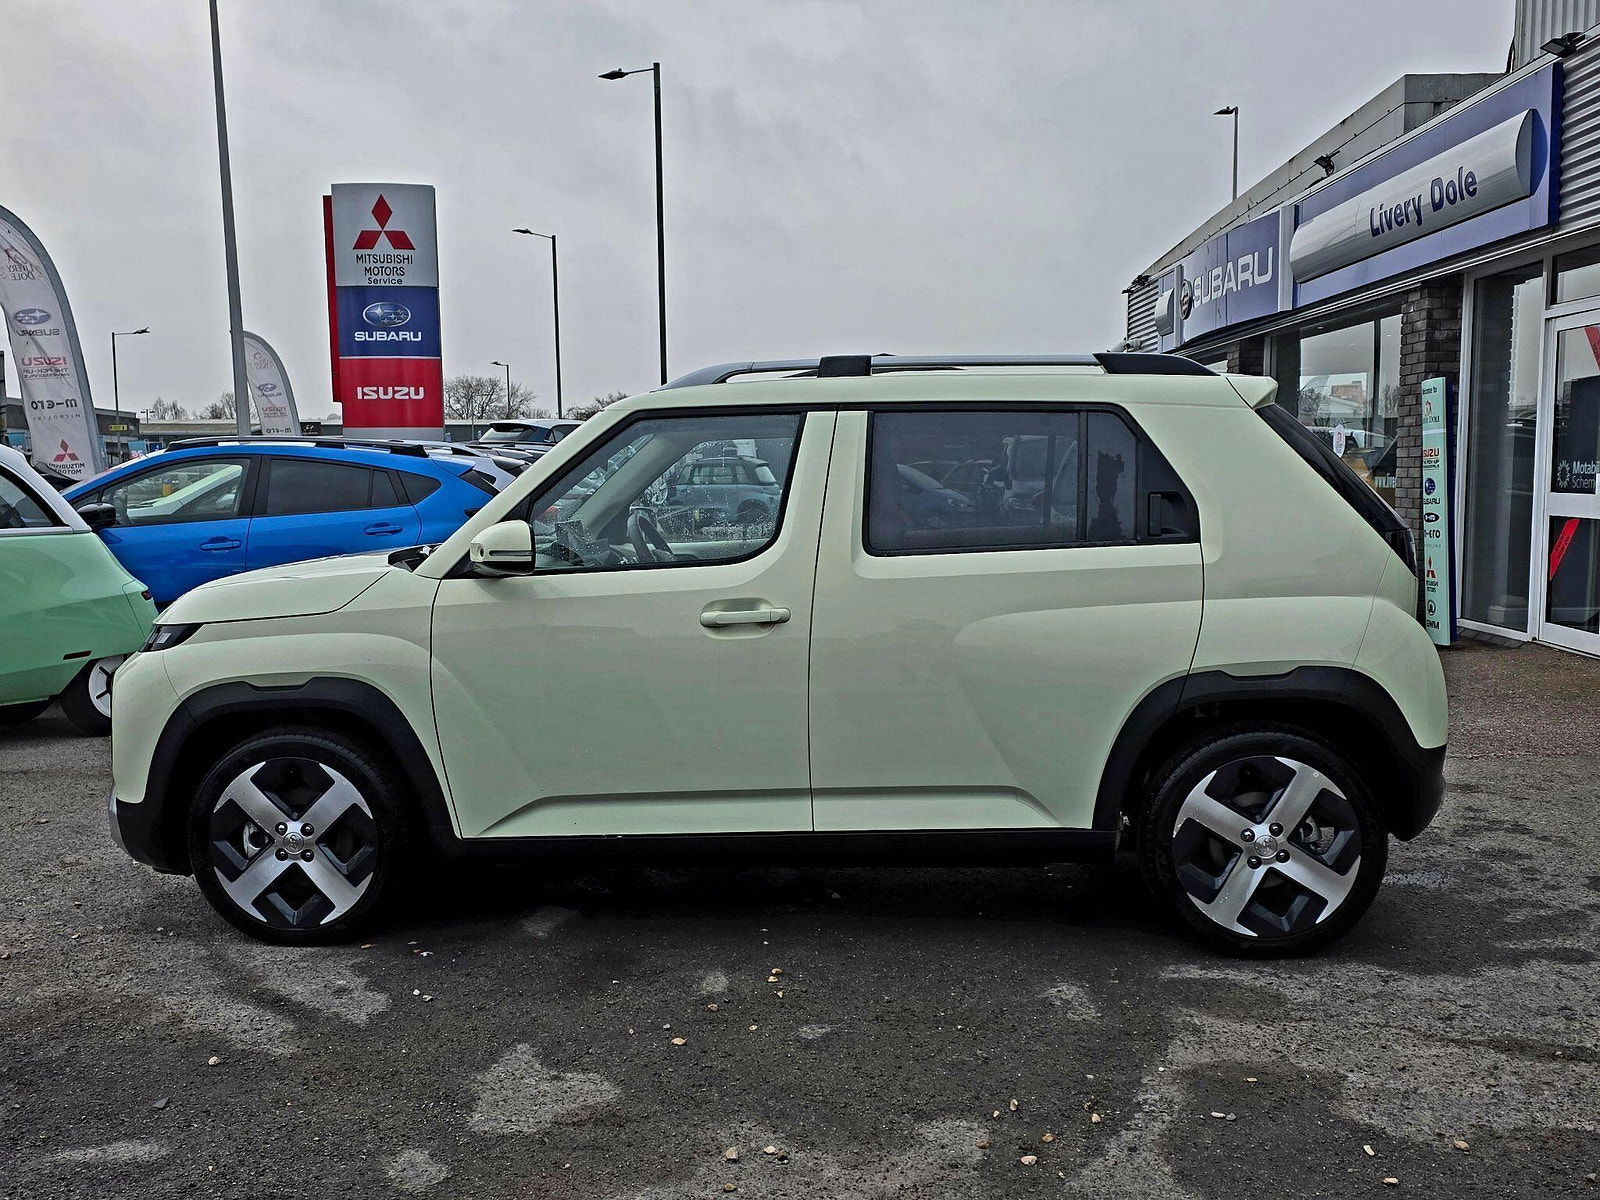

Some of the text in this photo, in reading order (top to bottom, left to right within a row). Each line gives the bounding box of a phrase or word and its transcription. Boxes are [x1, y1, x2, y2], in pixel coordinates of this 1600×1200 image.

[1369, 165, 1478, 238] Livery Dole
[355, 253, 413, 265] MITSUBISHI
[364, 266, 405, 277] MOTORS
[367, 276, 403, 285] Service
[1193, 246, 1274, 309] SUBARU
[354, 331, 422, 342] SUBARU
[356, 386, 425, 400] ISUZU
[1423, 448, 1440, 458] SUZU
